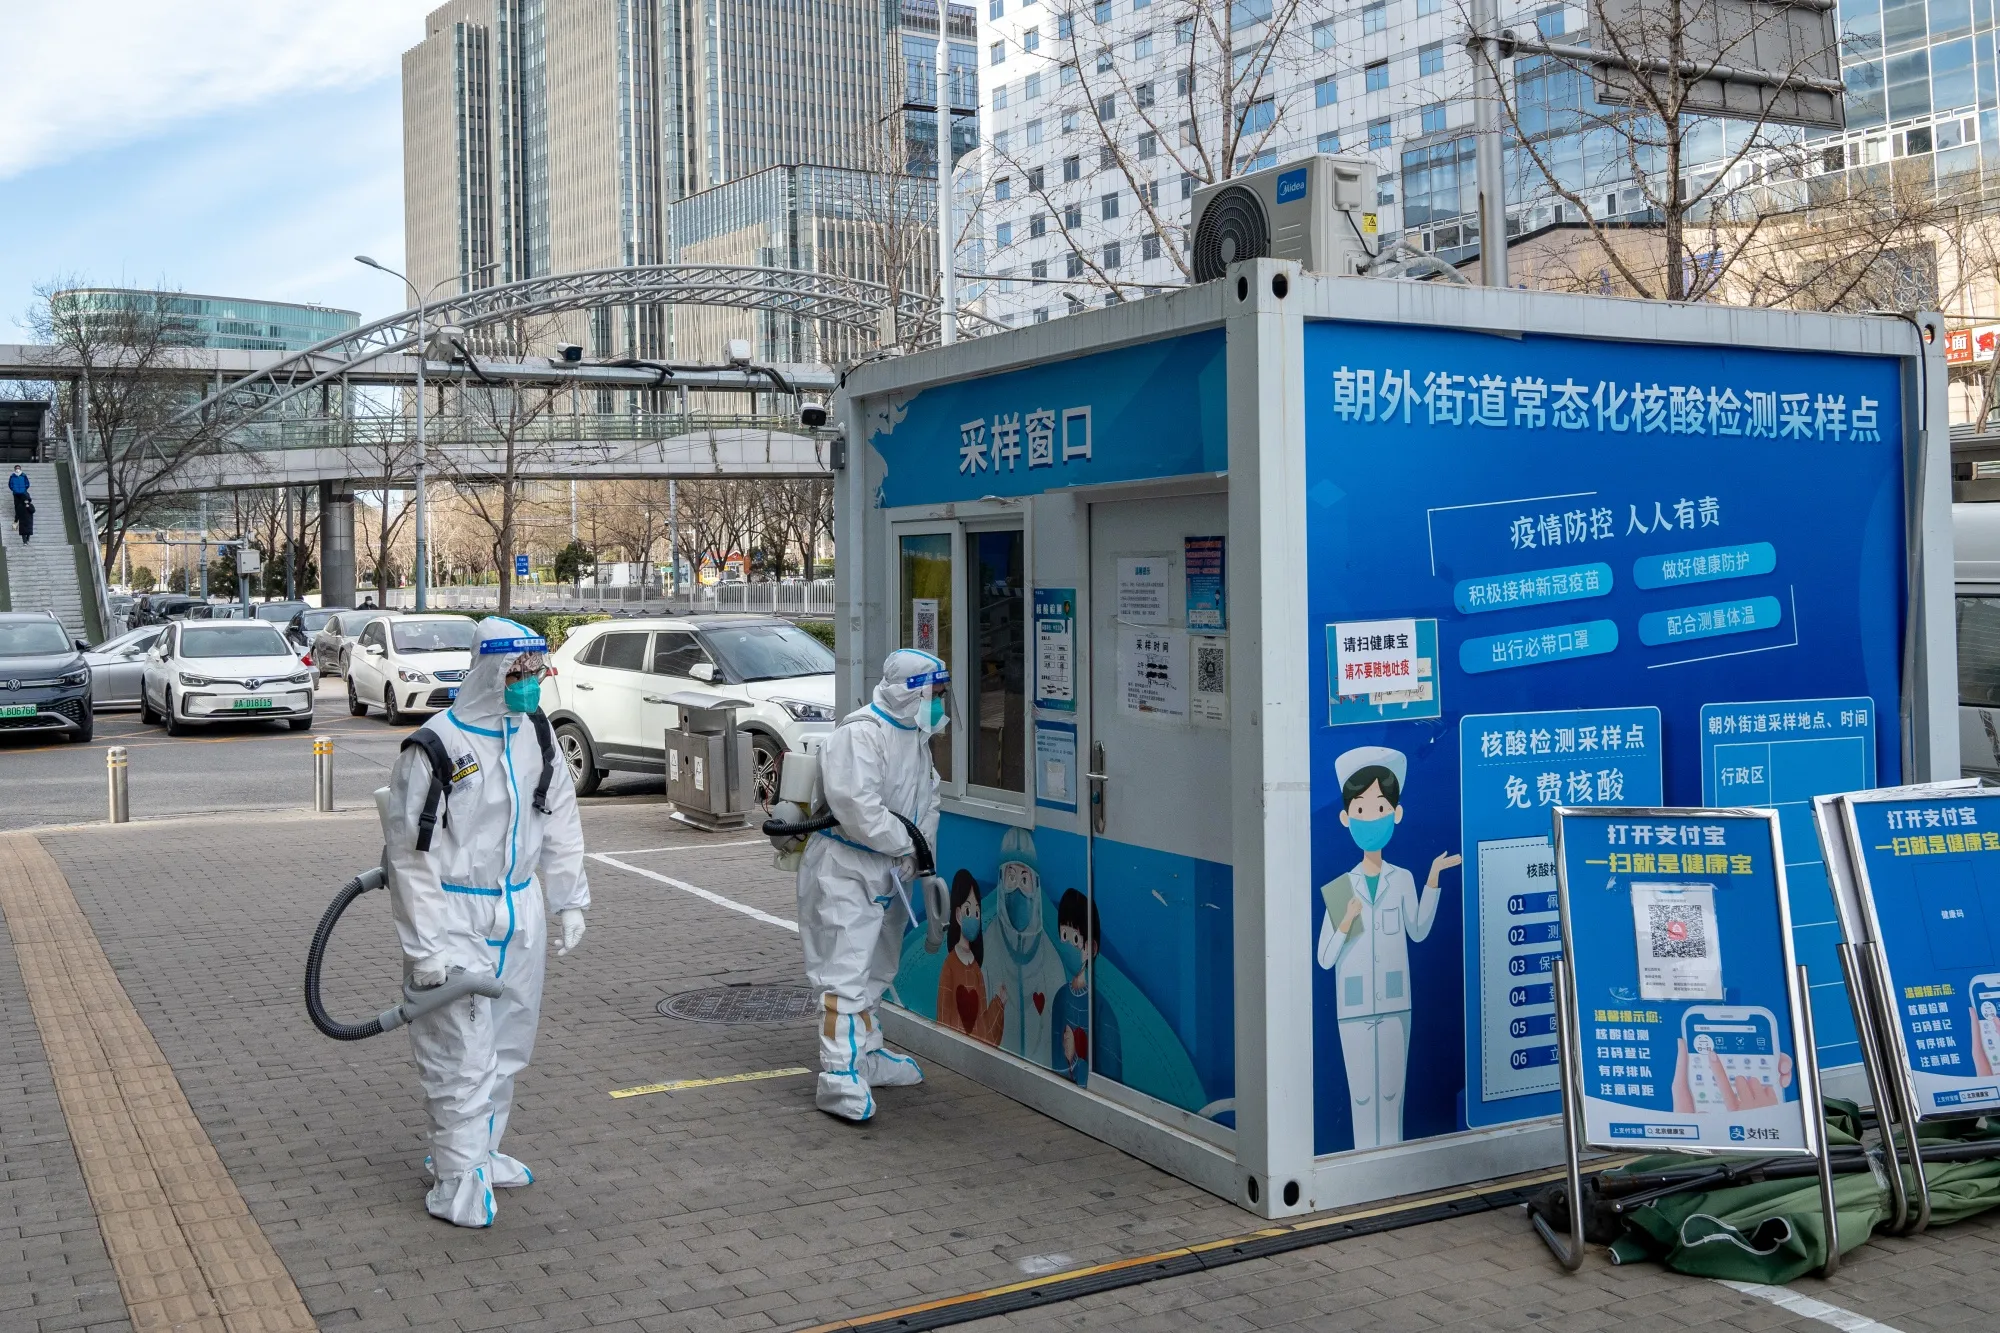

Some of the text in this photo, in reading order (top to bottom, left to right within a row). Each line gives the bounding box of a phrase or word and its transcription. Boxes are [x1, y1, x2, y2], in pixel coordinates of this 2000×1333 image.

[1279, 180, 1305, 196] Midea
[1332, 365, 1882, 443] 朝外街道常态化核酸检测采样点
[958, 404, 1093, 475] 采样窗口
[1510, 496, 1721, 550] 疫情防控 人人有责
[1661, 551, 1751, 581] 做好健康防护
[1468, 569, 1600, 607] 积极接种新冠疫苗
[1666, 605, 1756, 637] 配合测量体温
[1136, 638, 1169, 653] 采样时间
[1343, 633, 1410, 653] 请扫健康宝
[1491, 629, 1590, 663] 出行必带口罩
[1344, 659, 1410, 680] 请不要随地吐痰
[6, 705, 36, 716] B06766
[1708, 709, 1869, 735] 朝外街道采样地点、时间
[1480, 723, 1645, 758] 核酸检测采样点
[1720, 765, 1765, 786] 行政区
[1504, 767, 1625, 809] 免费核酸
[1886, 806, 1978, 830] 打开支付宝
[1607, 824, 1727, 846] 打开支付宝
[1875, 831, 2000, 857] 一扫就是健康宝
[1585, 852, 1754, 875] 一扫就是健康宝
[1509, 898, 1524, 912] 01
[1941, 909, 1965, 920] 健康码
[1510, 928, 1525, 943] 02
[1511, 959, 1526, 974] 03
[1511, 990, 1526, 1004] 04
[1908, 1002, 1949, 1016] 核酸检测
[1512, 1021, 1527, 1035] 05
[1911, 1019, 1953, 1034] 扫码登记
[1595, 1028, 1650, 1041] 核酸检测
[1915, 1036, 1957, 1051] 有序排队
[1512, 1051, 1527, 1066] 06
[1597, 1046, 1651, 1059] 扫码登记
[1920, 1053, 1961, 1068] 注意间距
[1598, 1064, 1653, 1078] 有序排队
[1600, 1083, 1655, 1097] 注意间距
[1654, 1127, 1686, 1136] 北京健康宝
[1746, 1128, 1780, 1140] 支付宝
